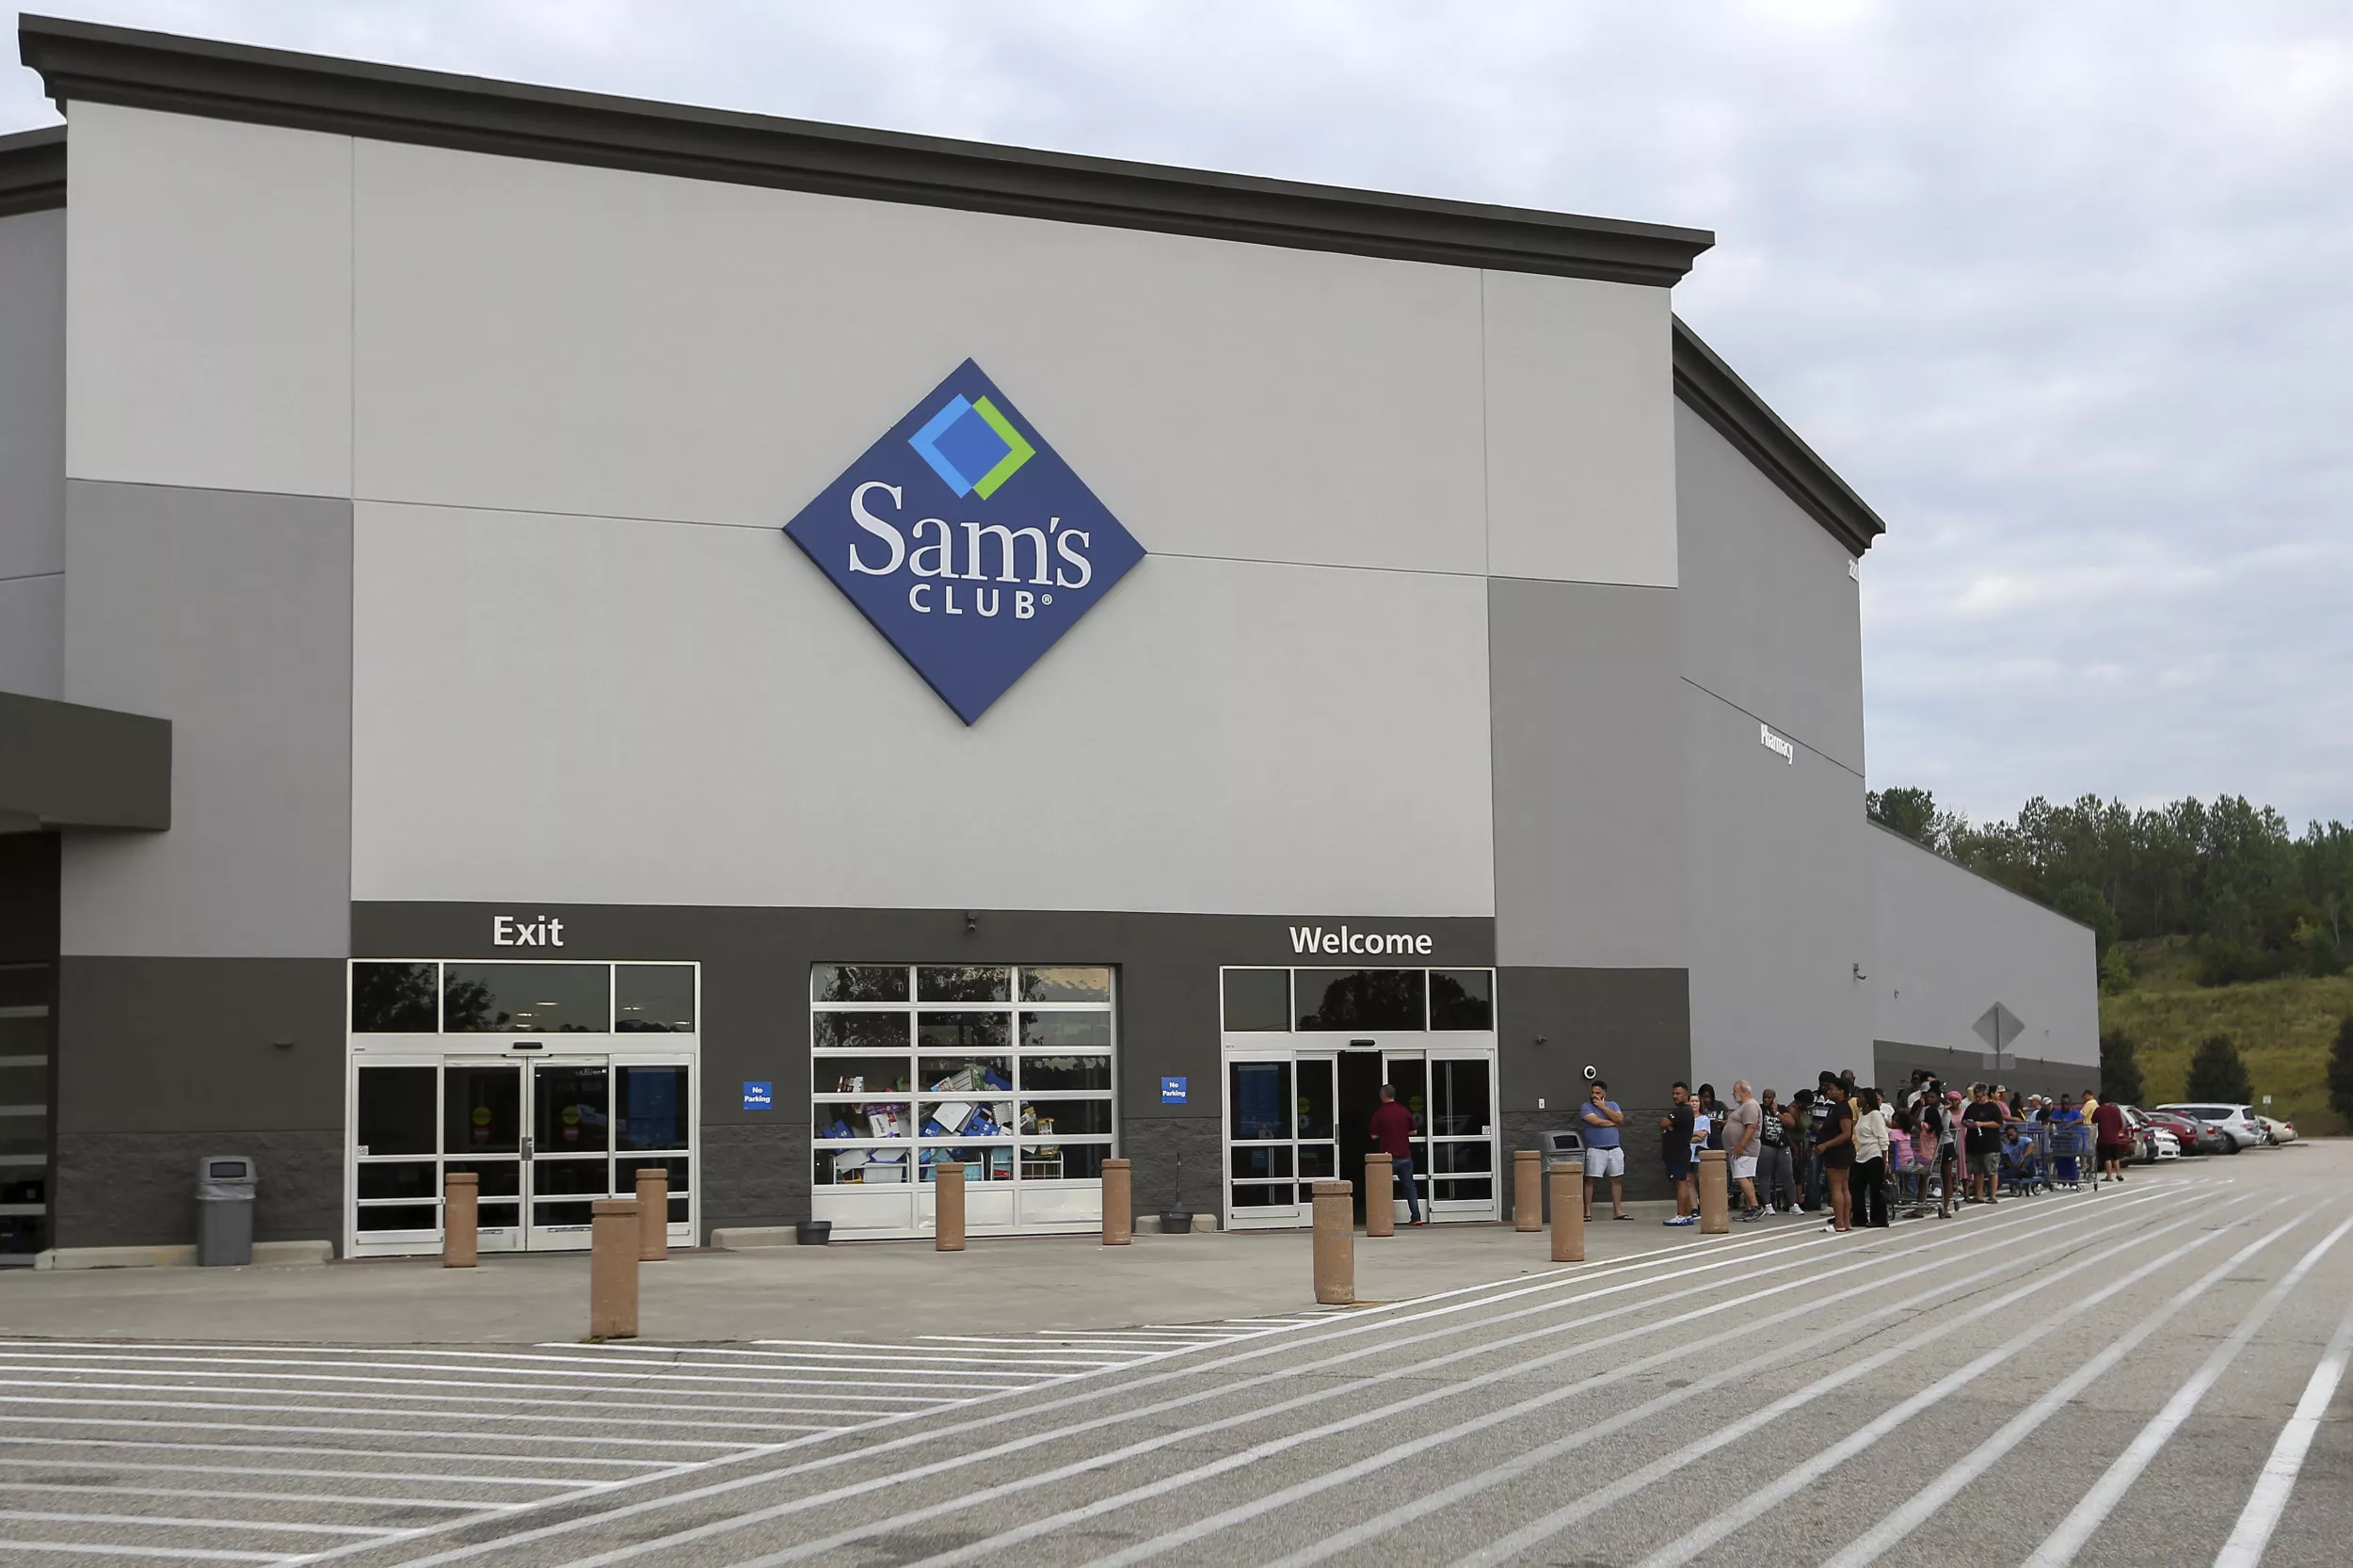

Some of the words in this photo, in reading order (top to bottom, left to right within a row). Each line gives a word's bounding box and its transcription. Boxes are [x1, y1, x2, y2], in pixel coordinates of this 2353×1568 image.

[848, 480, 1093, 590] Sam's
[1760, 723, 1794, 765] Pharmacy
[493, 914, 564, 947] Exit
[1289, 924, 1433, 955] Welcome
[744, 1095, 771, 1104] Parking
